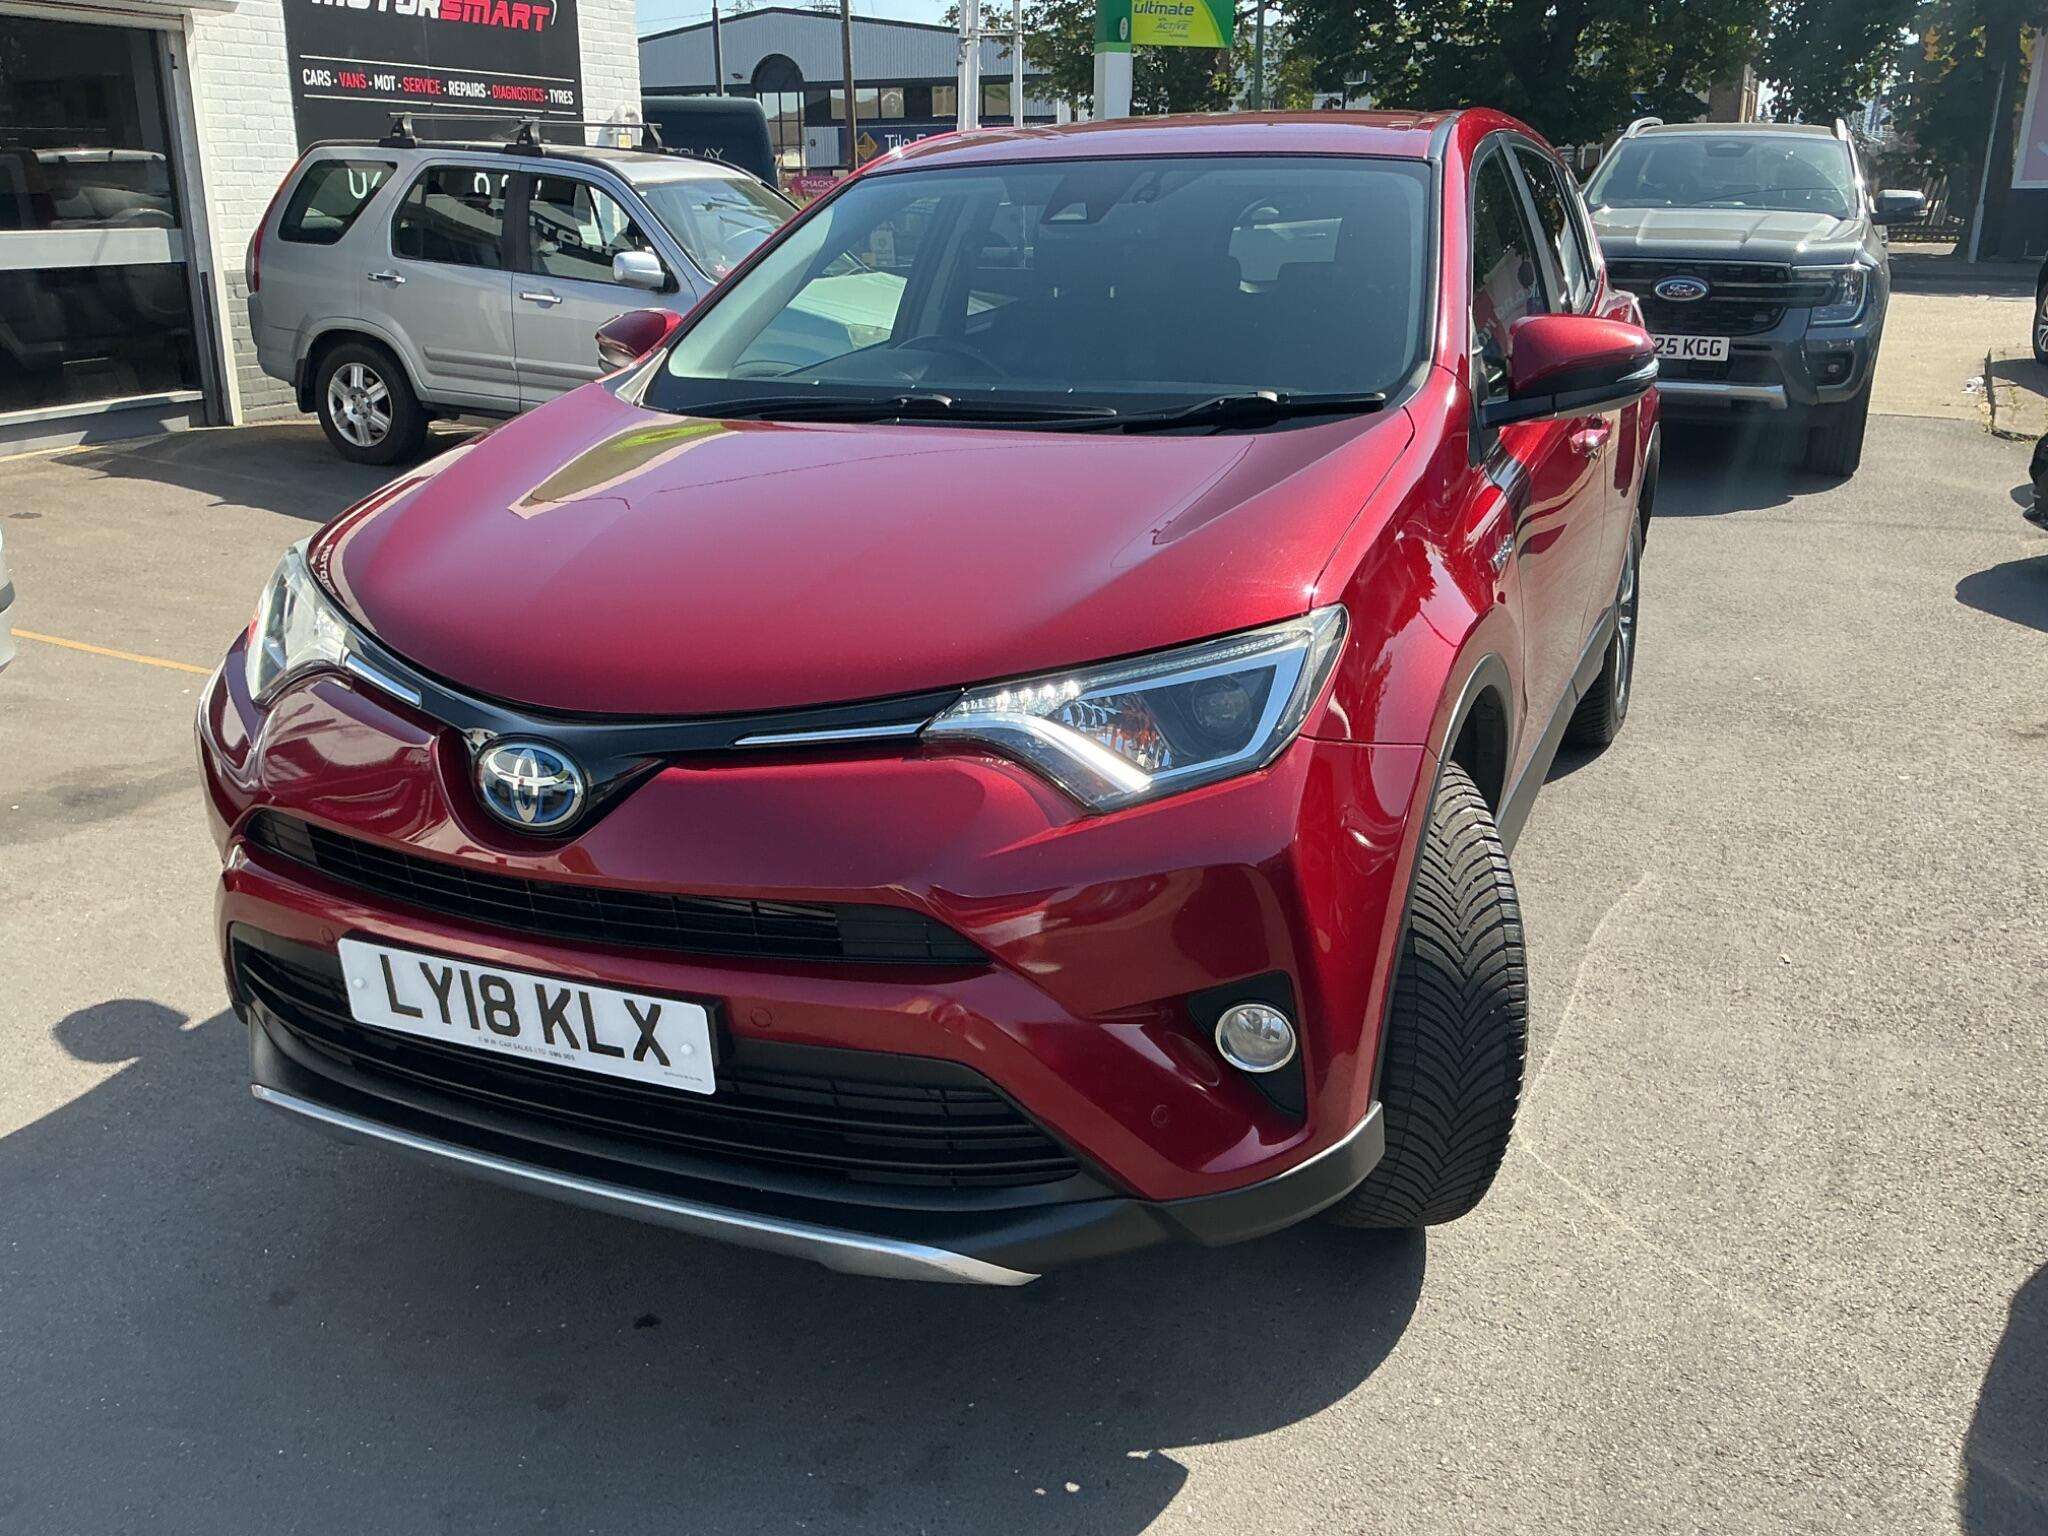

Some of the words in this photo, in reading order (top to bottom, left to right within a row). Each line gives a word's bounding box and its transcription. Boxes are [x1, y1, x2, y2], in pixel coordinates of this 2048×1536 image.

[311, 0, 550, 32] ORSMART
[1134, 0, 1194, 16] ultimate
[302, 68, 332, 87] CARS
[339, 71, 367, 89] VANS
[373, 74, 396, 91] MOT
[402, 76, 441, 95] SERVICE
[448, 80, 486, 98] REPAIRS
[492, 84, 544, 102] DIAGNOSTICS
[548, 88, 574, 105] TYRES
[1683, 338, 1722, 357] KGG
[379, 953, 521, 1038] LY18
[534, 982, 672, 1067] KLX
